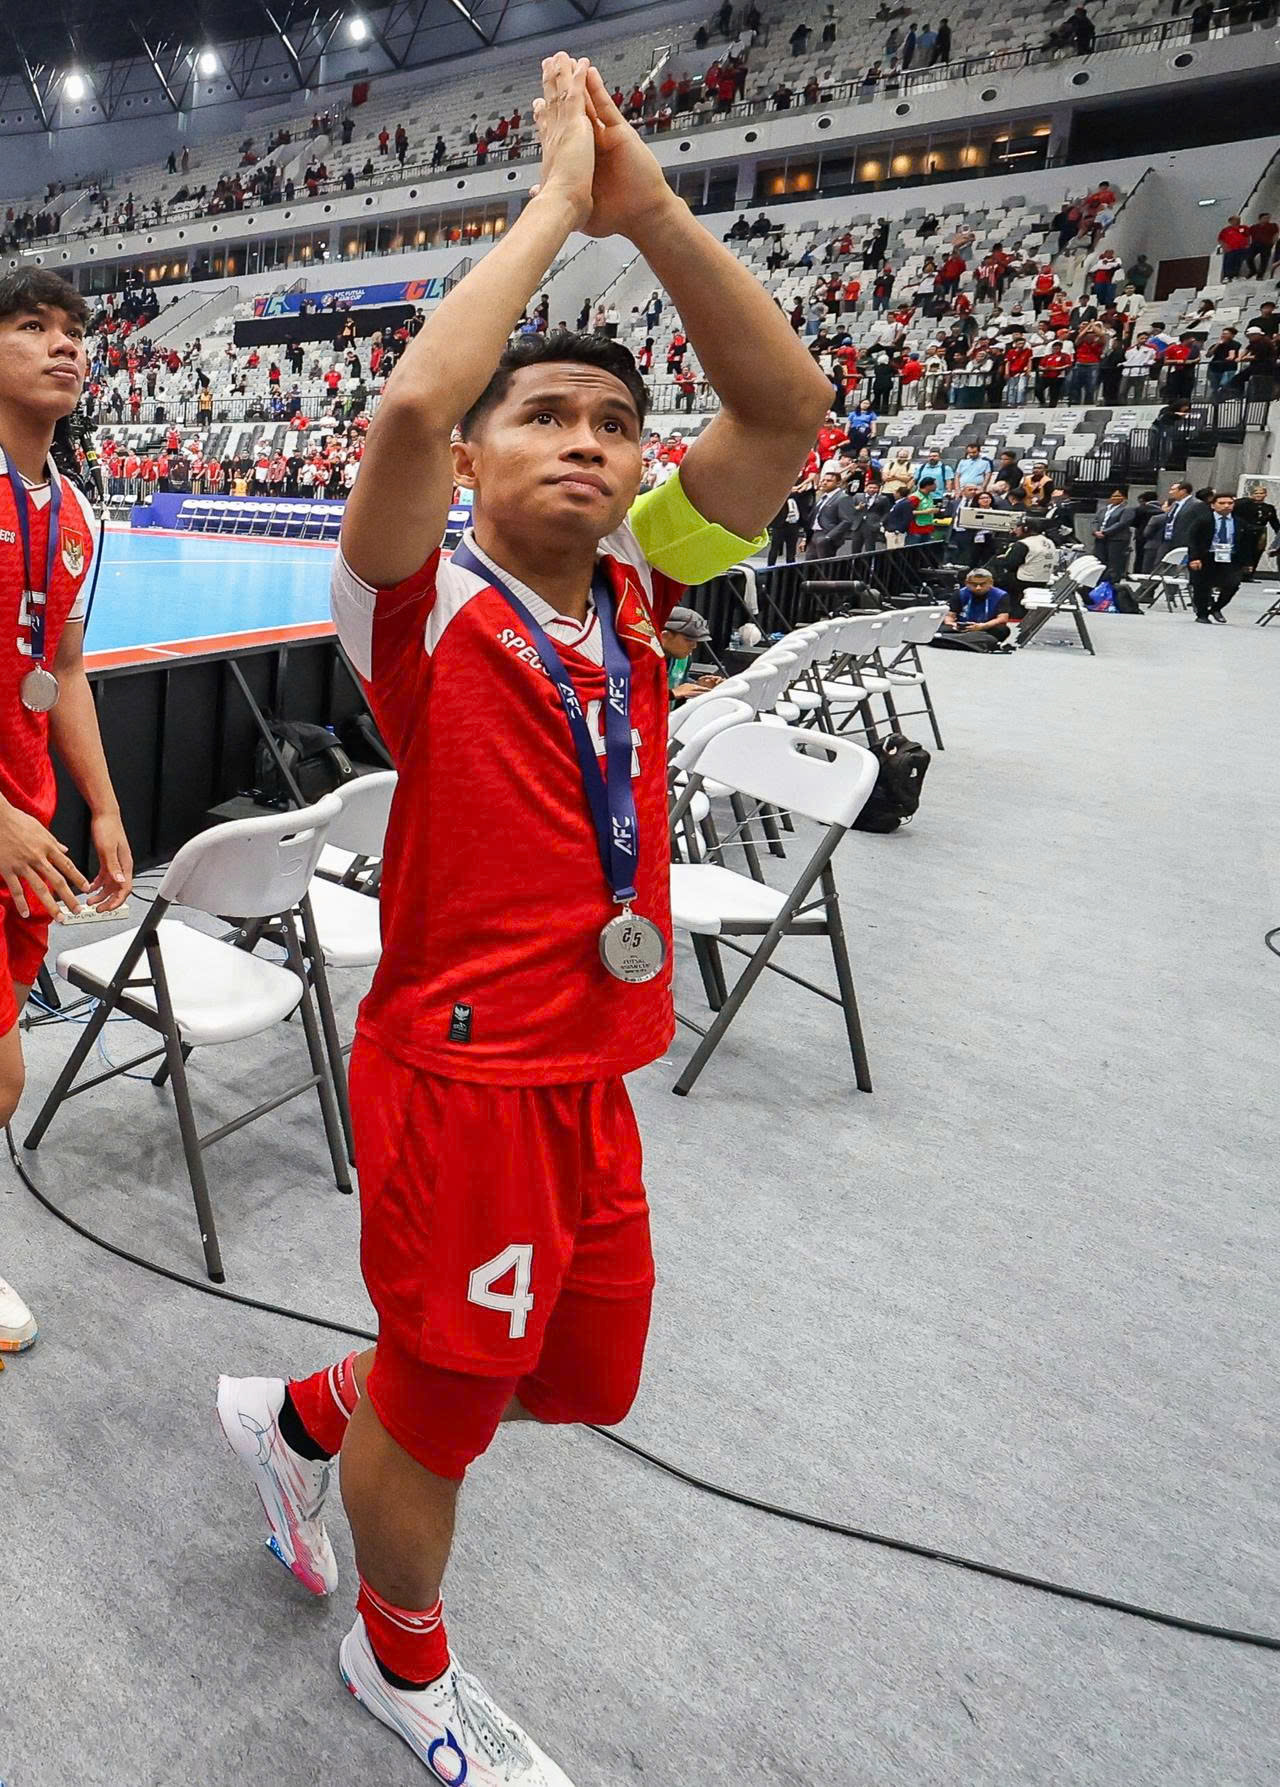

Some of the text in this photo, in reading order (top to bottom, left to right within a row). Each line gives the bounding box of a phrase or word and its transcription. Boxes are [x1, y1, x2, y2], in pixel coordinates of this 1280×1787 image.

[558, 682, 583, 719] AFC
[608, 676, 627, 716] AFC
[611, 815, 634, 856] AFC
[467, 1244, 534, 1339] 4
